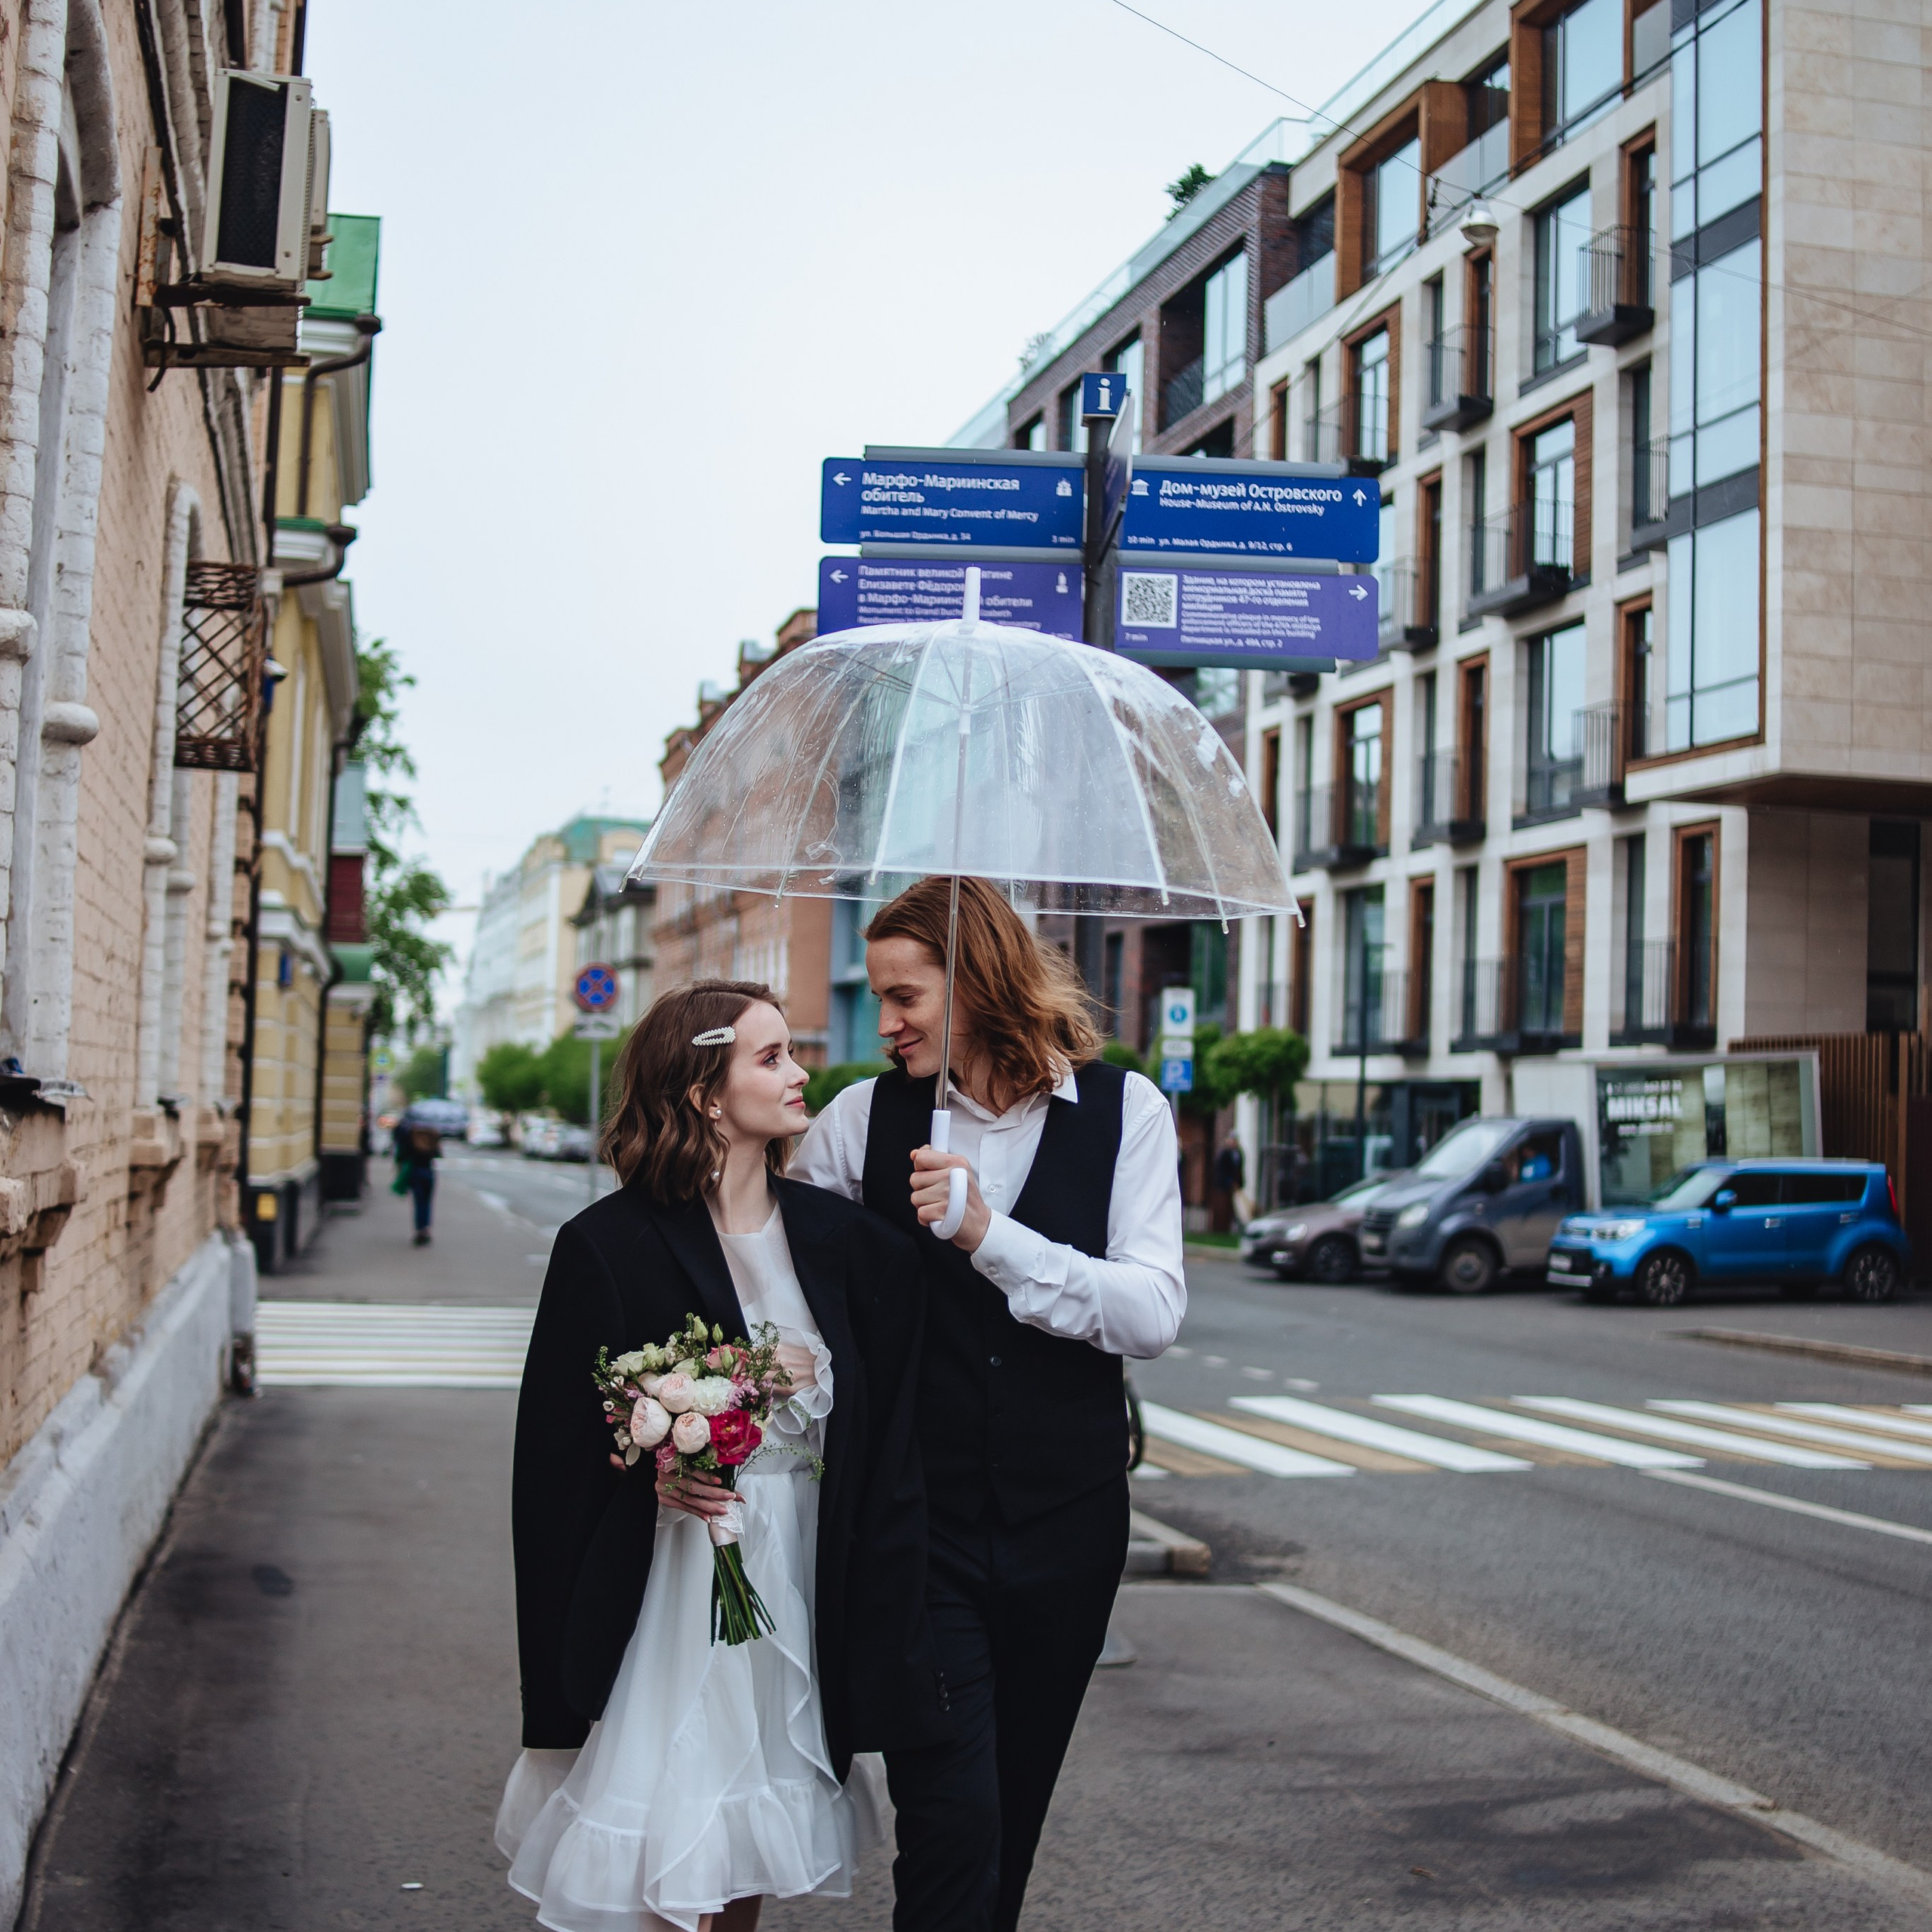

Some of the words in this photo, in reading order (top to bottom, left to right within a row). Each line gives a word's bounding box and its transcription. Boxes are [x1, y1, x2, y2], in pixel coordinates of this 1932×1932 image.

[862, 472, 1020, 491] Марфо-Мариинская
[861, 488, 924, 503] обитель
[1159, 479, 1247, 499] Дом-музей
[1248, 483, 1343, 503] Островского
[860, 506, 900, 515] Martha
[901, 507, 921, 516] and
[922, 507, 949, 519] Mary
[950, 508, 992, 518] Convent
[994, 509, 1005, 519] of
[1008, 509, 1039, 522] Mercy
[1159, 497, 1239, 510] House-Museum
[1241, 500, 1253, 511] of
[1274, 502, 1325, 516] Ostrovsky
[1140, 536, 1155, 545] min
[858, 565, 916, 576] Памятник
[918, 568, 964, 578] великой
[858, 579, 915, 589] Елизавете
[986, 595, 1032, 607] обители
[1608, 1096, 1683, 1121] MIKSAL
